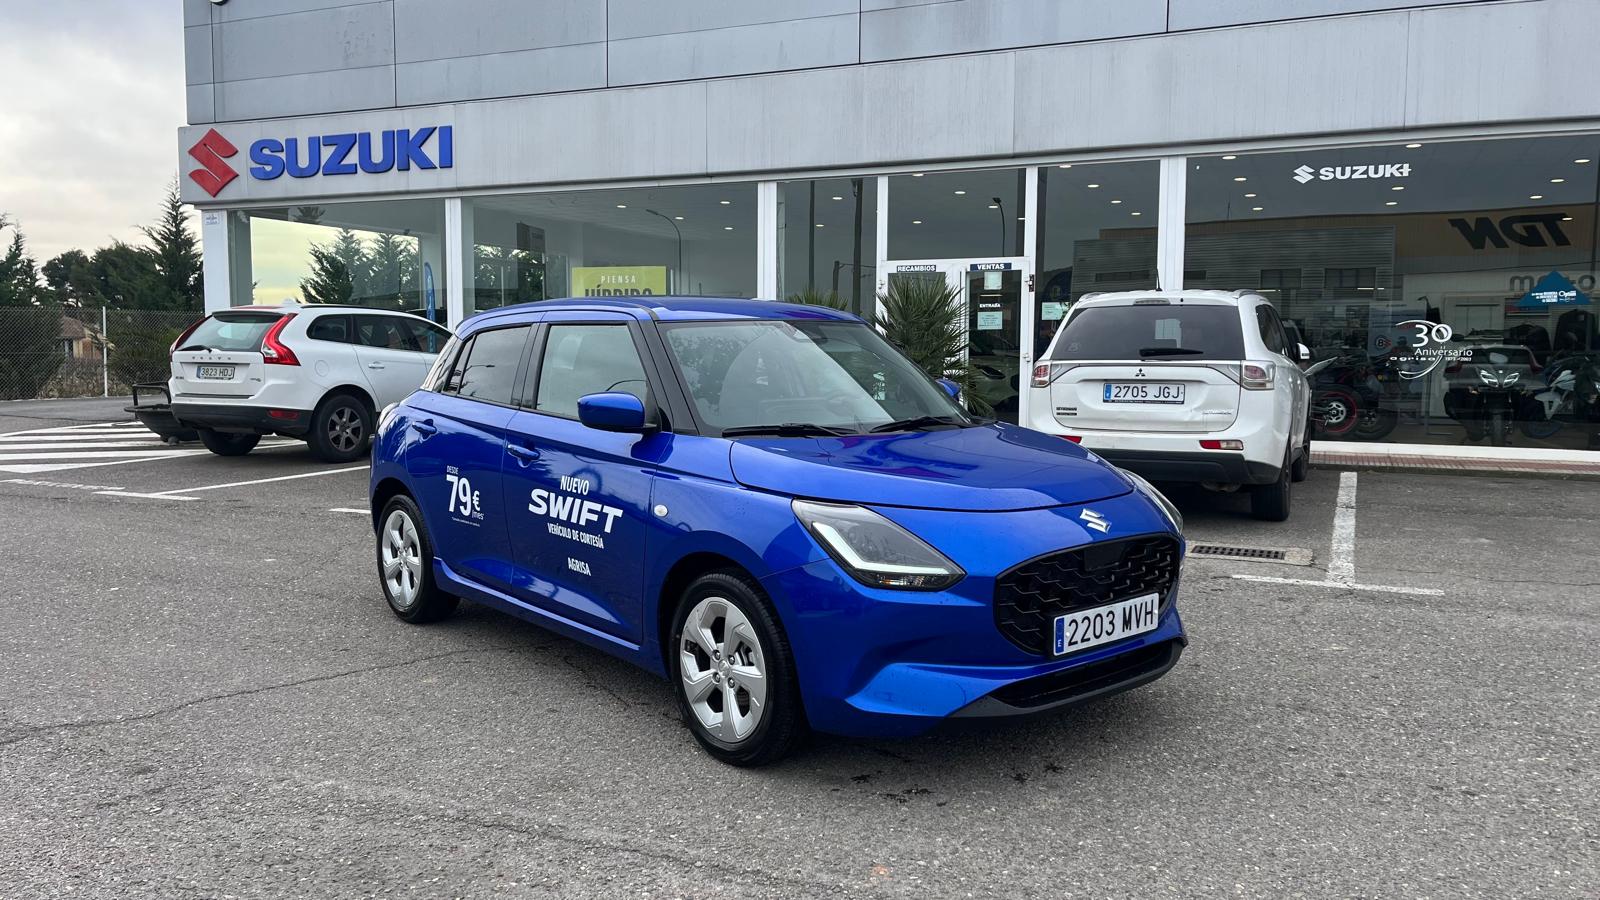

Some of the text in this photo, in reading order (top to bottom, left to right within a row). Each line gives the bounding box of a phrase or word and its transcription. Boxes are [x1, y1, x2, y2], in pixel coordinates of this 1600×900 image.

[249, 125, 453, 181] SUZUKI
[1318, 163, 1410, 181] SUZUKI
[600, 275, 636, 284] PIENSA
[1412, 324, 1452, 347] 30
[1414, 347, 1473, 357] Aniversario
[200, 366, 218, 377] 3823
[1114, 385, 1181, 399] 2705 JGJ
[560, 475, 590, 496] NUEVO
[528, 488, 624, 534] SWIFT
[547, 522, 604, 549] VEHÍCULO DE CORTESÍA
[567, 556, 592, 577] AGRISA
[1067, 599, 1154, 647] 2203 MVH
